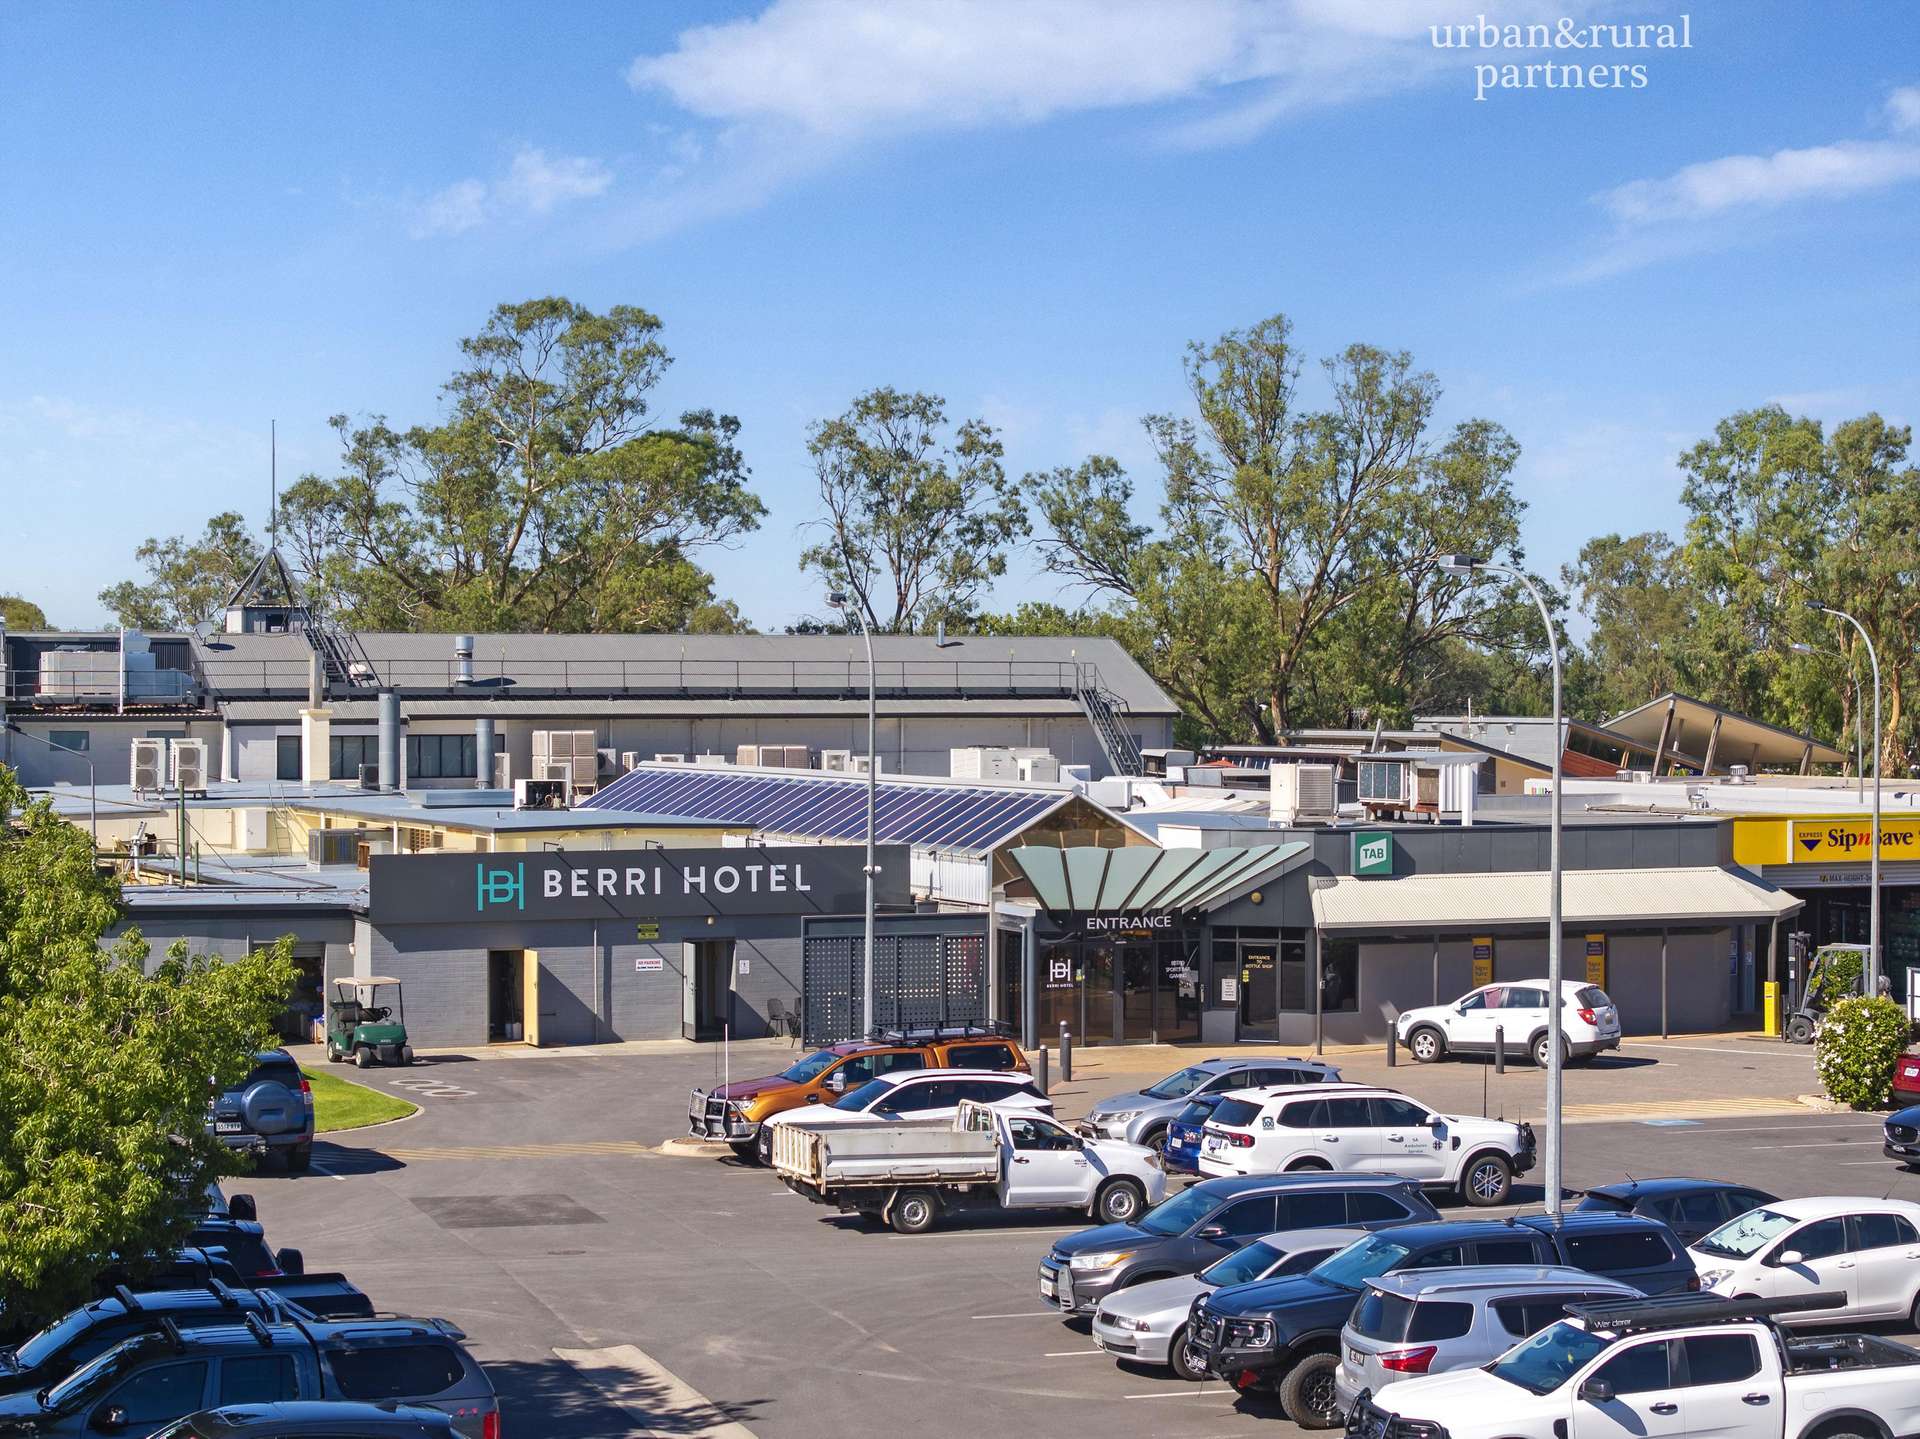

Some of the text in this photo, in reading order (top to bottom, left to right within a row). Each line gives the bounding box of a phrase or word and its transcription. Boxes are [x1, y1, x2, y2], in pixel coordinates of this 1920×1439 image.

[1362, 847, 1384, 859] TAB
[543, 863, 811, 898] BERRI HOTEL
[1086, 915, 1172, 930] ENTRANCE
